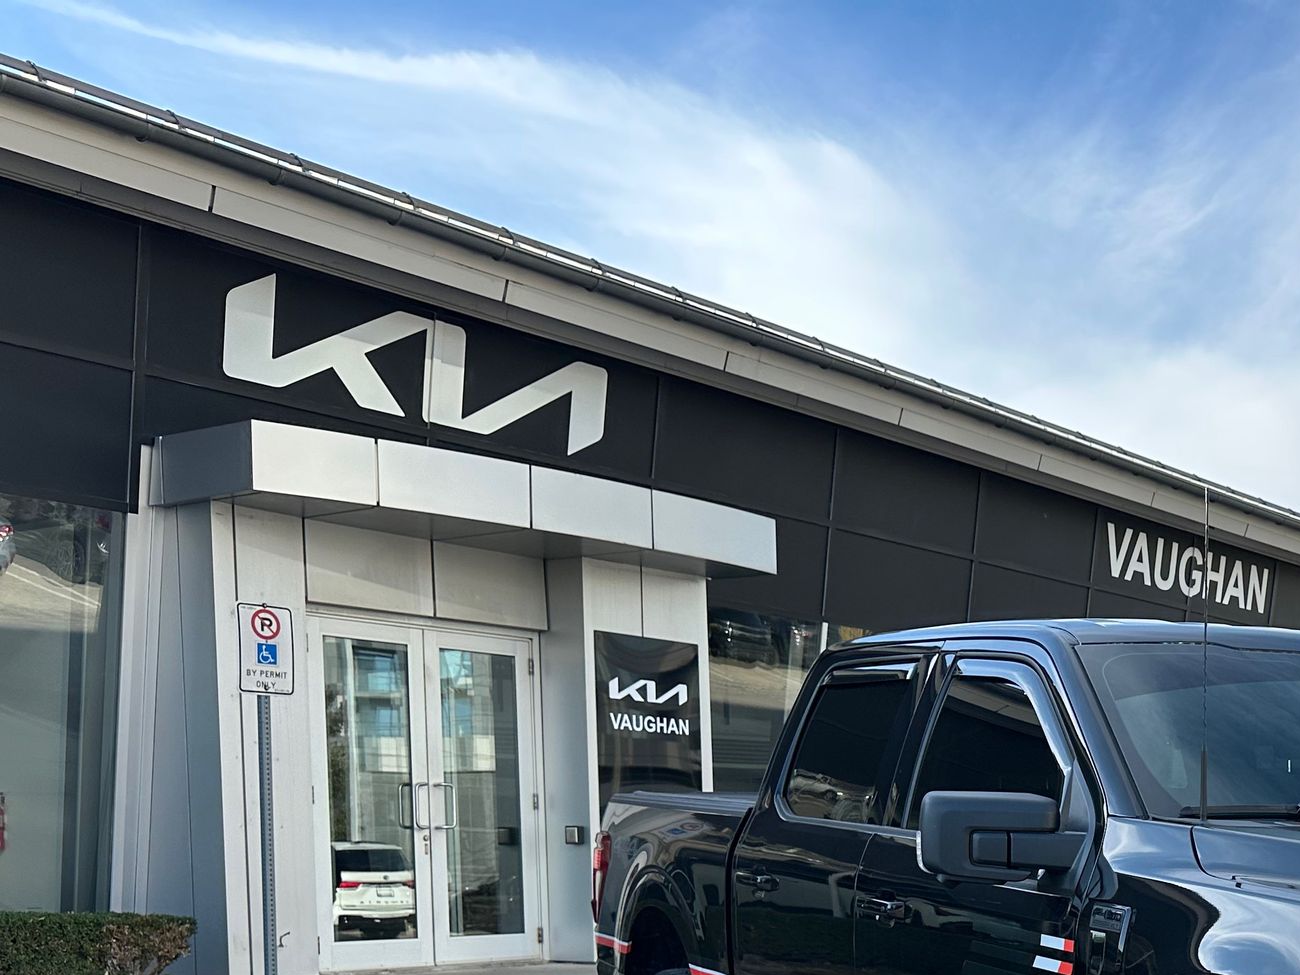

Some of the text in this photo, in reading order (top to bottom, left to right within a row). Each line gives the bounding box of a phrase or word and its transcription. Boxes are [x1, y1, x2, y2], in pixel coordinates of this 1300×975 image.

[222, 272, 609, 457] KIA
[1107, 521, 1270, 615] VAUGHAN
[246, 668, 288, 680] BY PERMIT
[608, 676, 688, 706] KIA
[609, 712, 690, 736] VAUGHAN
